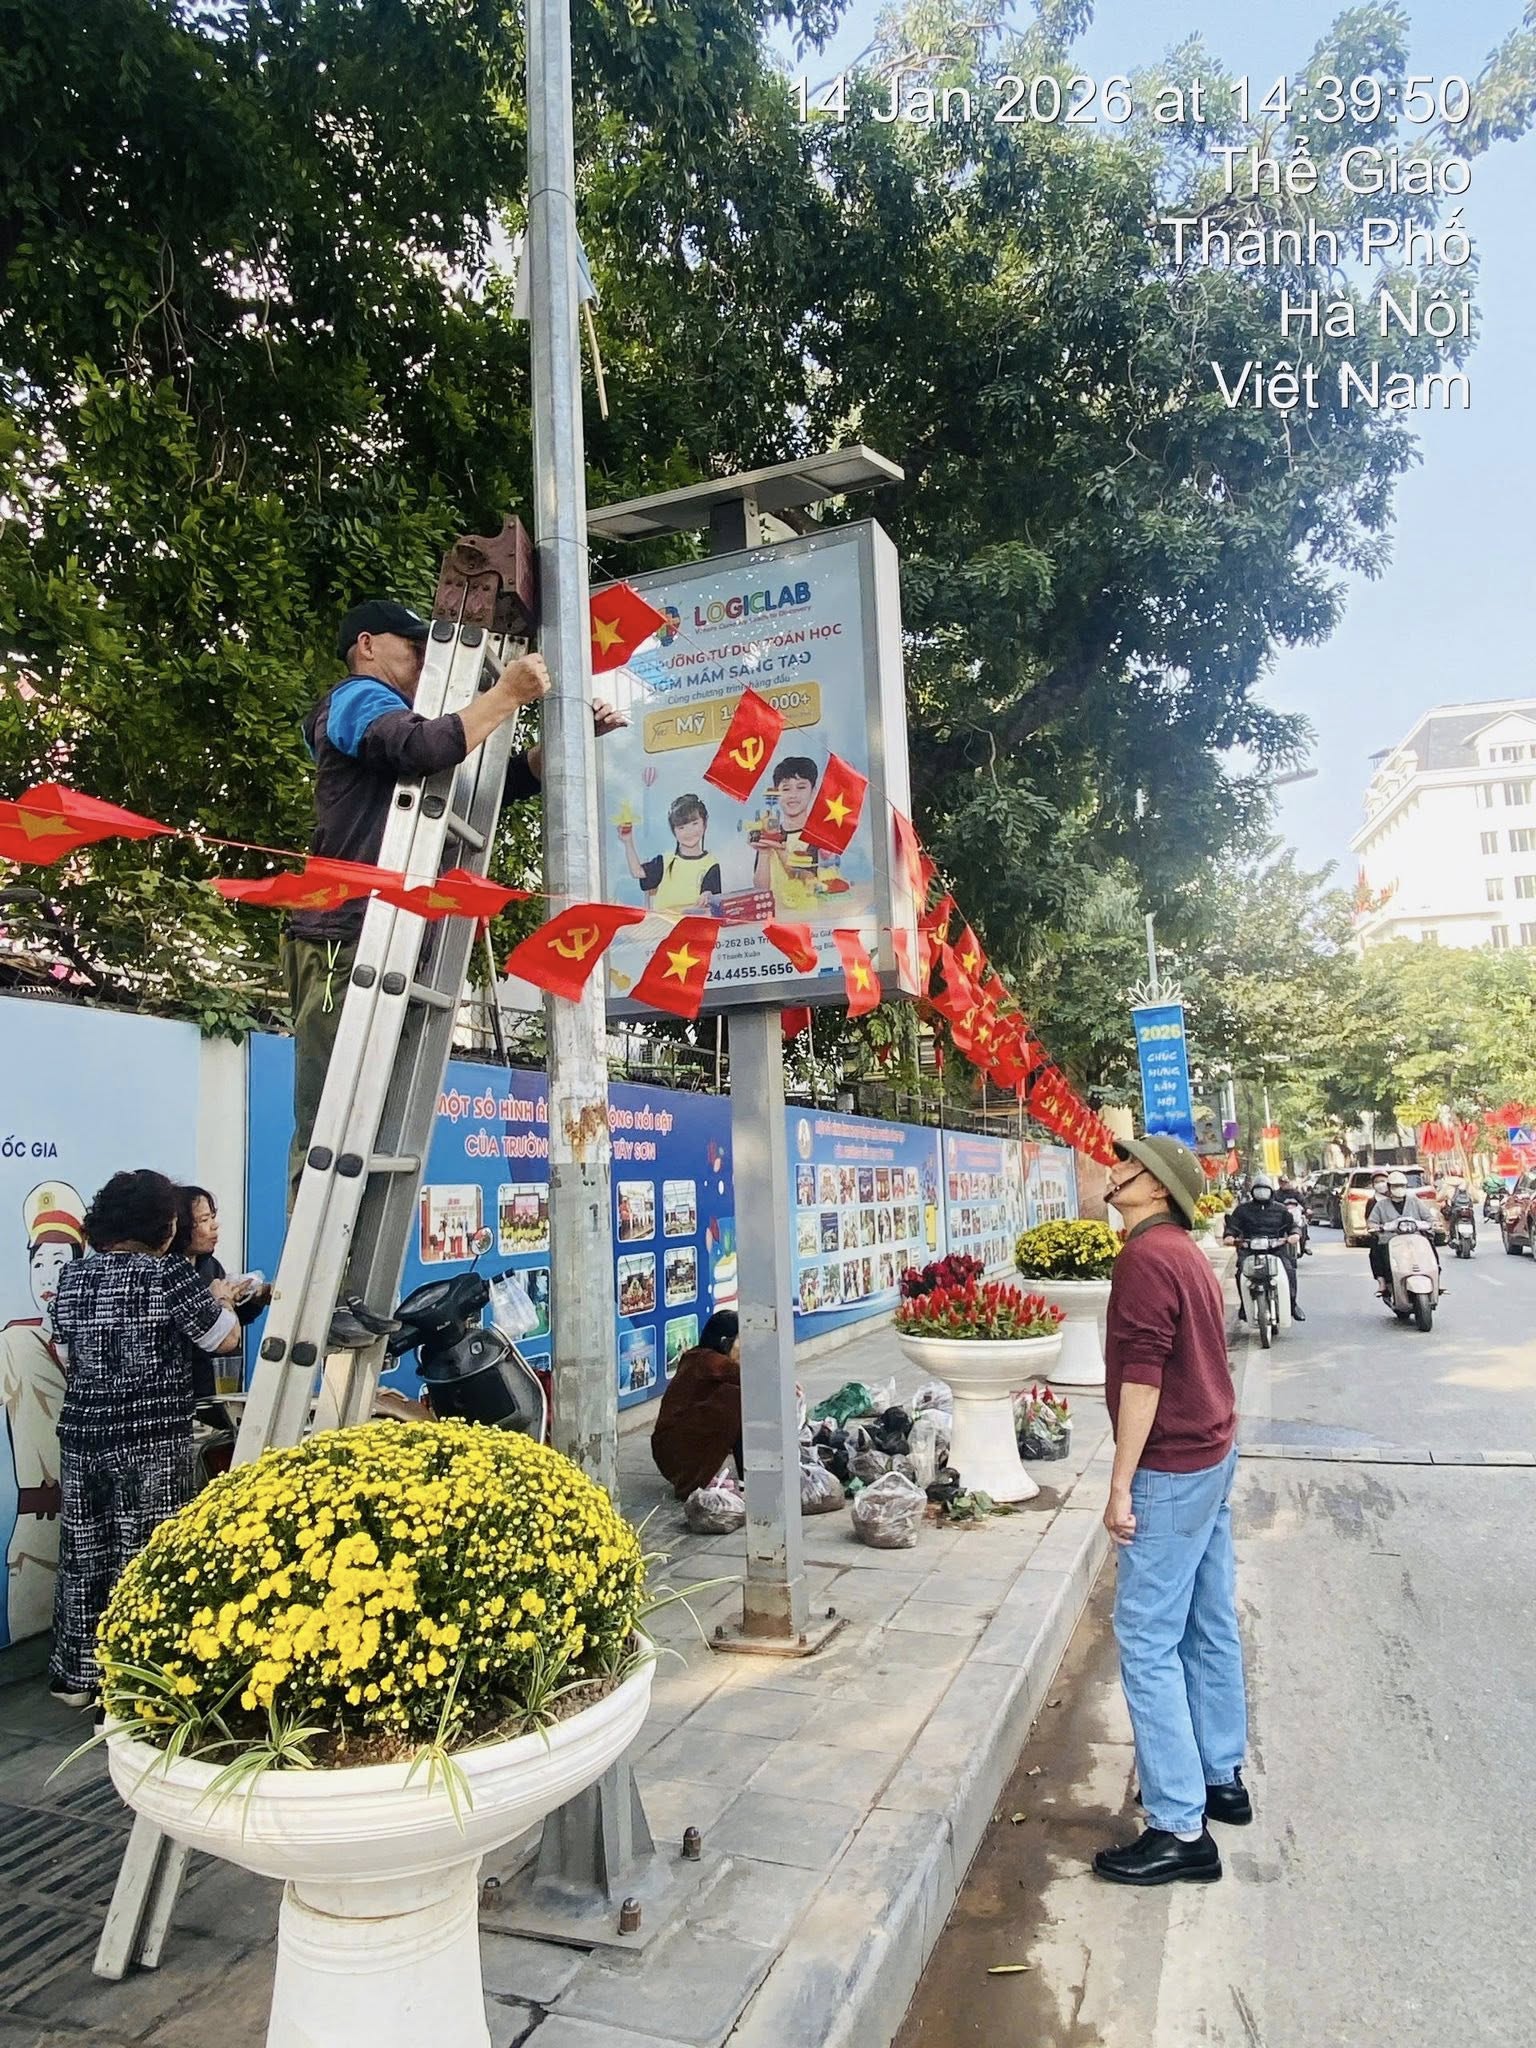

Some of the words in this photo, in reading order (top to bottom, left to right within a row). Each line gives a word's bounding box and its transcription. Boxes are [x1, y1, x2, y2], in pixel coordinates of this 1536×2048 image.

[694, 581, 812, 627] LOGICLAB
[809, 623, 843, 641] HỌC
[778, 651, 812, 671] TẠO
[676, 712, 706, 736] Mỹ
[706, 962, 794, 981] 24.4455.5656
[473, 1087, 496, 1120] SỐ
[499, 1093, 534, 1122] HÌNH
[608, 1104, 634, 1133] ỘNG
[1, 1134, 26, 1157] ỐC
[31, 1142, 58, 1157] GIA
[464, 1127, 500, 1157] CỦA
